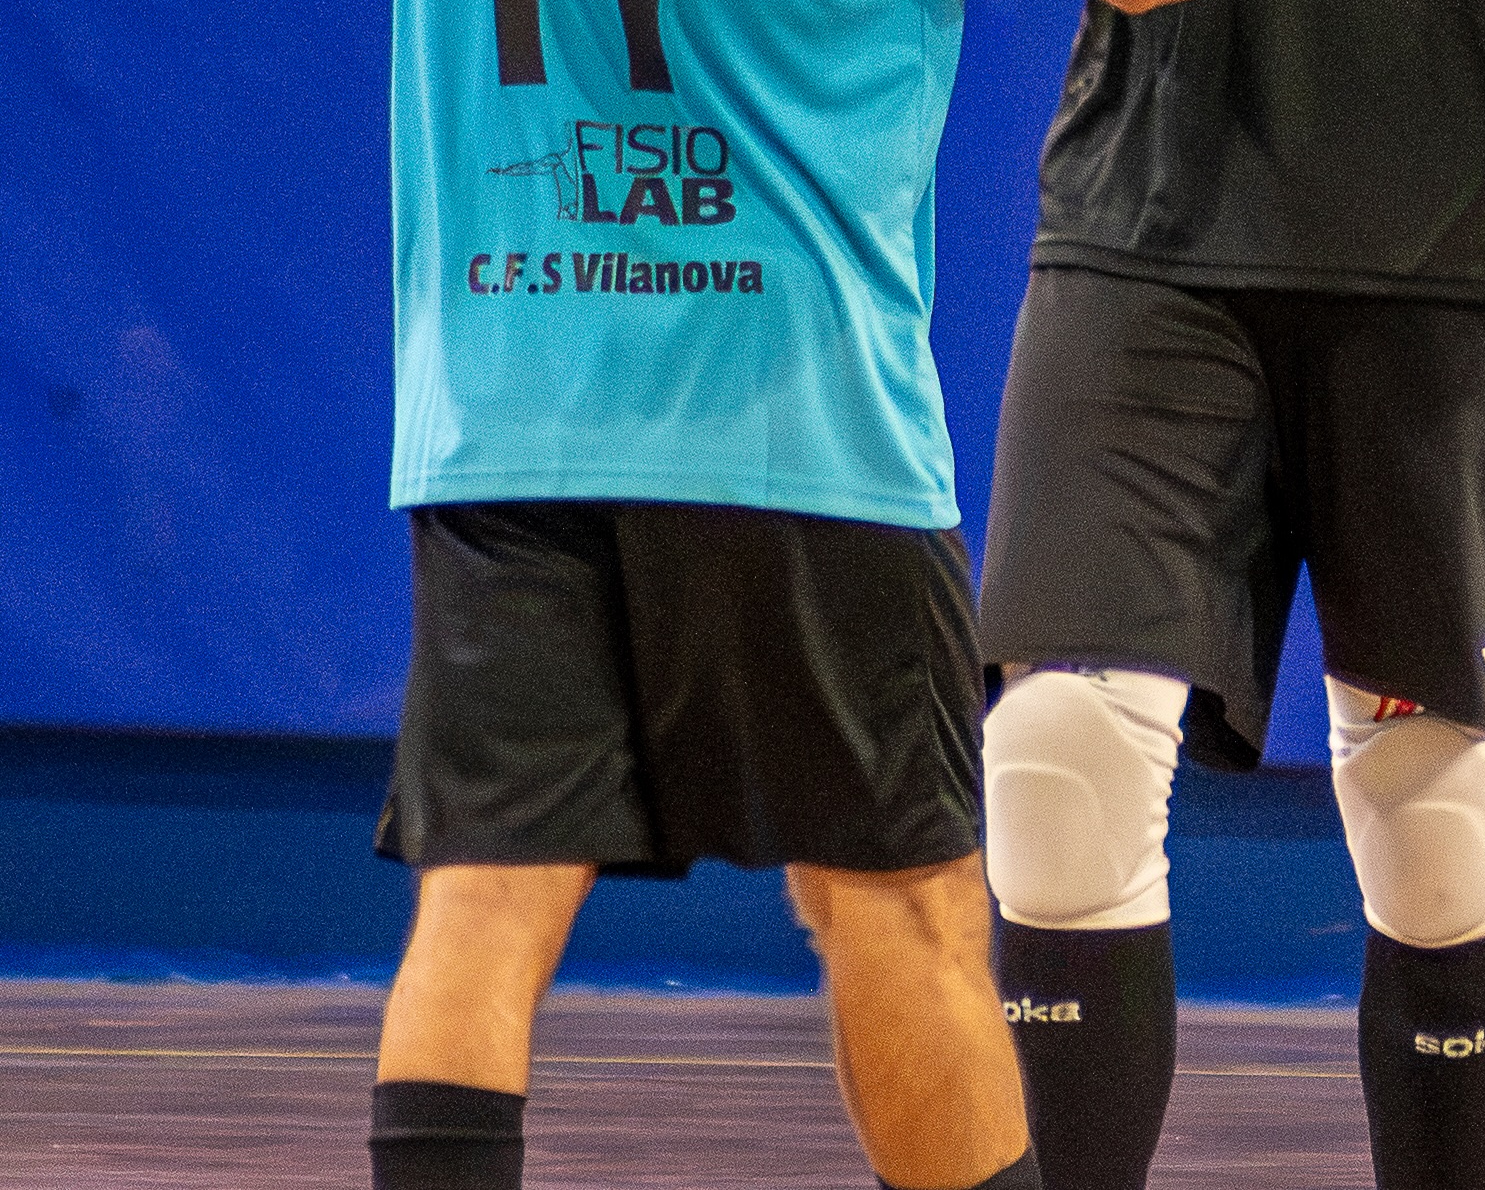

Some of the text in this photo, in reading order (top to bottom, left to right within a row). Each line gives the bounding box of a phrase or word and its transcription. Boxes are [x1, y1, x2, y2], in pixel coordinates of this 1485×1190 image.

[575, 120, 728, 176] FISIO
[581, 174, 737, 226] LAB
[468, 252, 764, 295] C.F.S Vilanova
[1003, 997, 1081, 1022] oka
